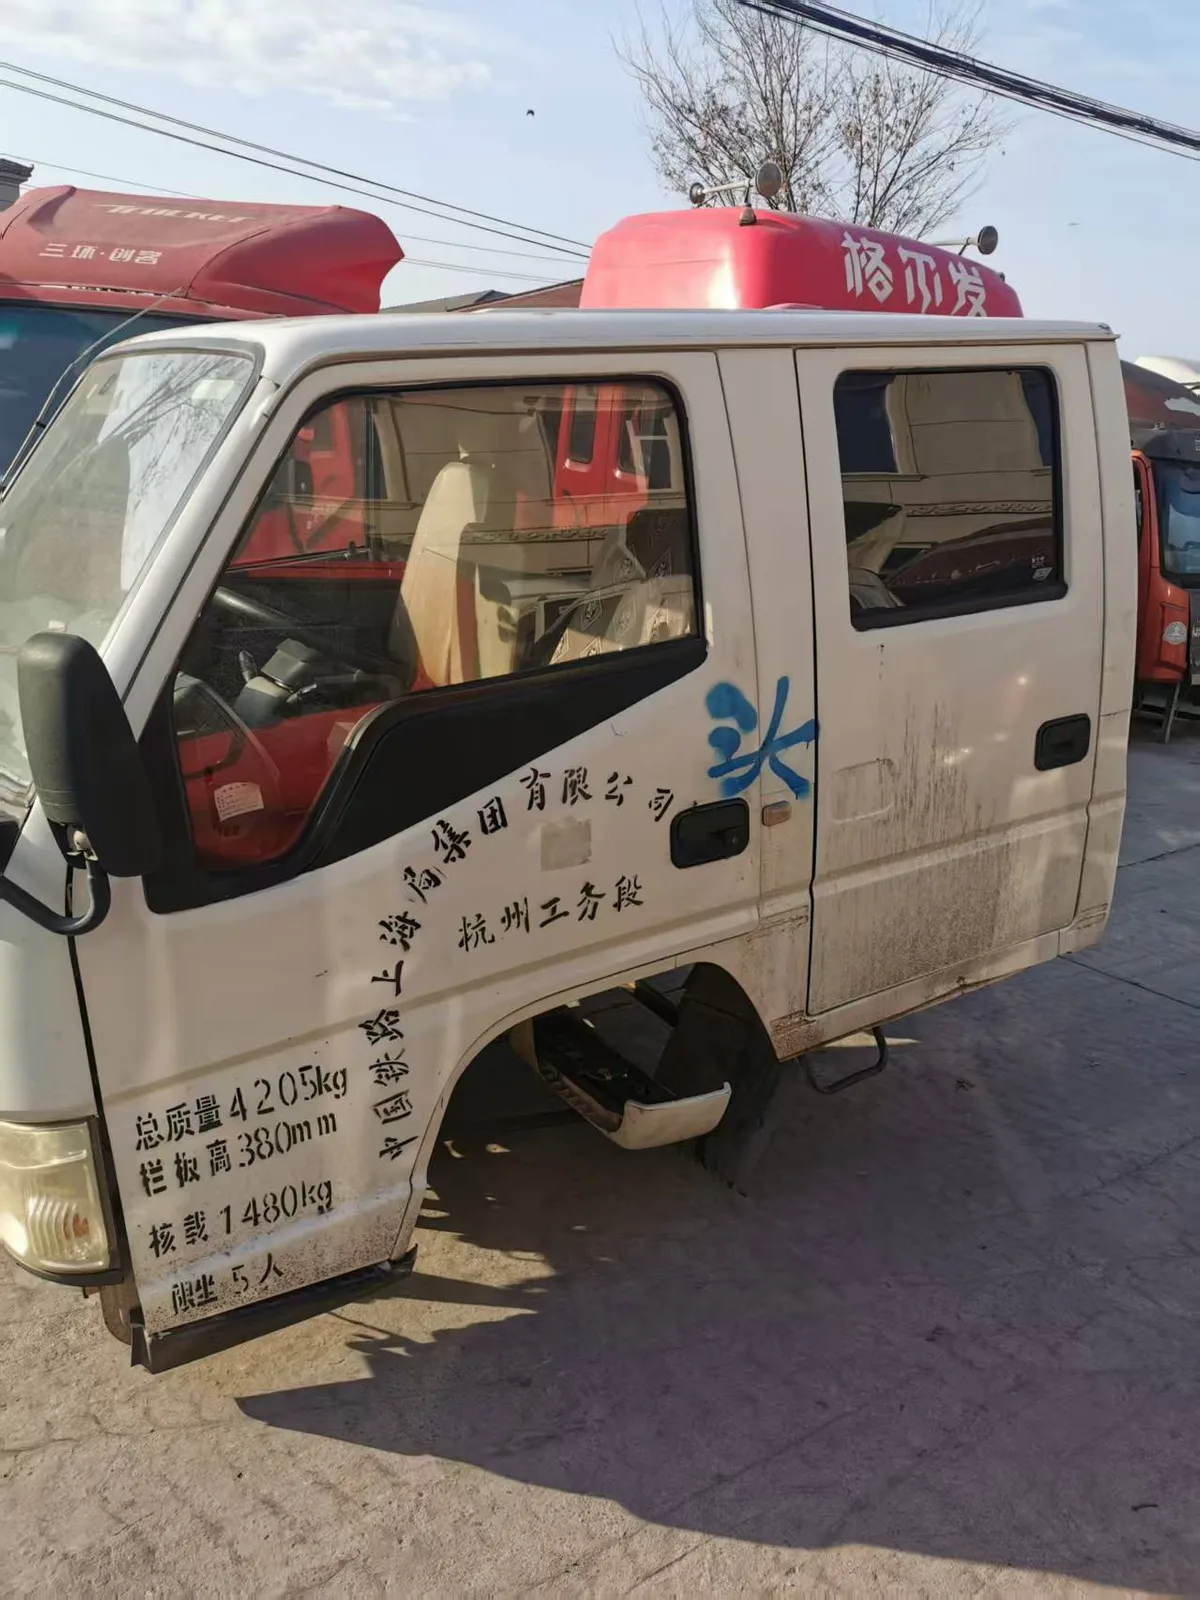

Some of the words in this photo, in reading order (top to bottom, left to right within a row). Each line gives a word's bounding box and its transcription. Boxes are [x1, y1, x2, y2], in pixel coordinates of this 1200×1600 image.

[841, 231, 988, 317] 格尔发
[457, 874, 644, 952] 杭州工务段
